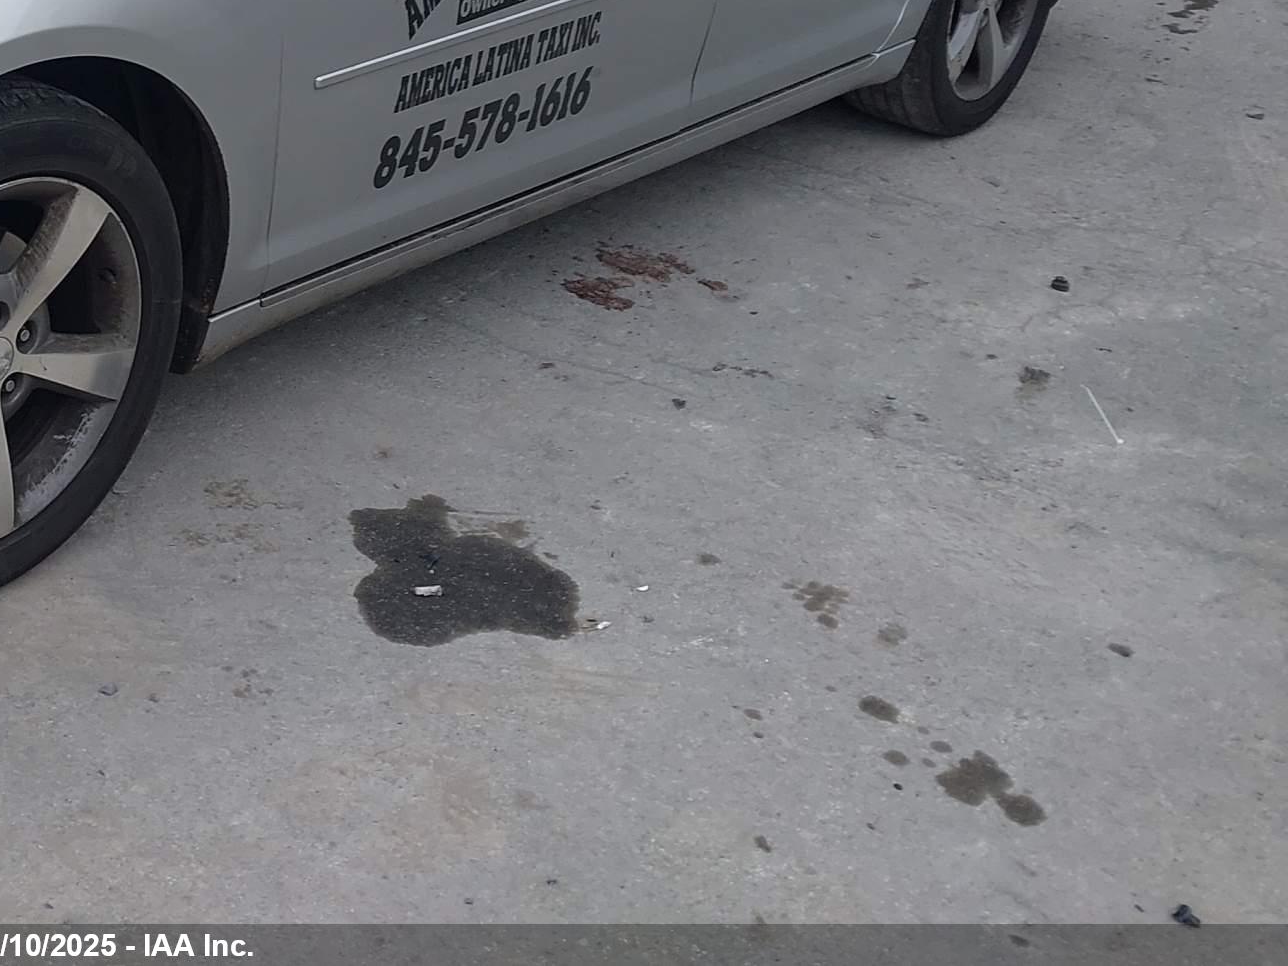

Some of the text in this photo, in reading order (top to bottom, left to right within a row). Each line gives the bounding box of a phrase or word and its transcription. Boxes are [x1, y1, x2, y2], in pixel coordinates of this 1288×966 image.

[394, 10, 602, 113] AMERICA LATINA TAXI INC.
[373, 65, 594, 189] 845-578-1616
